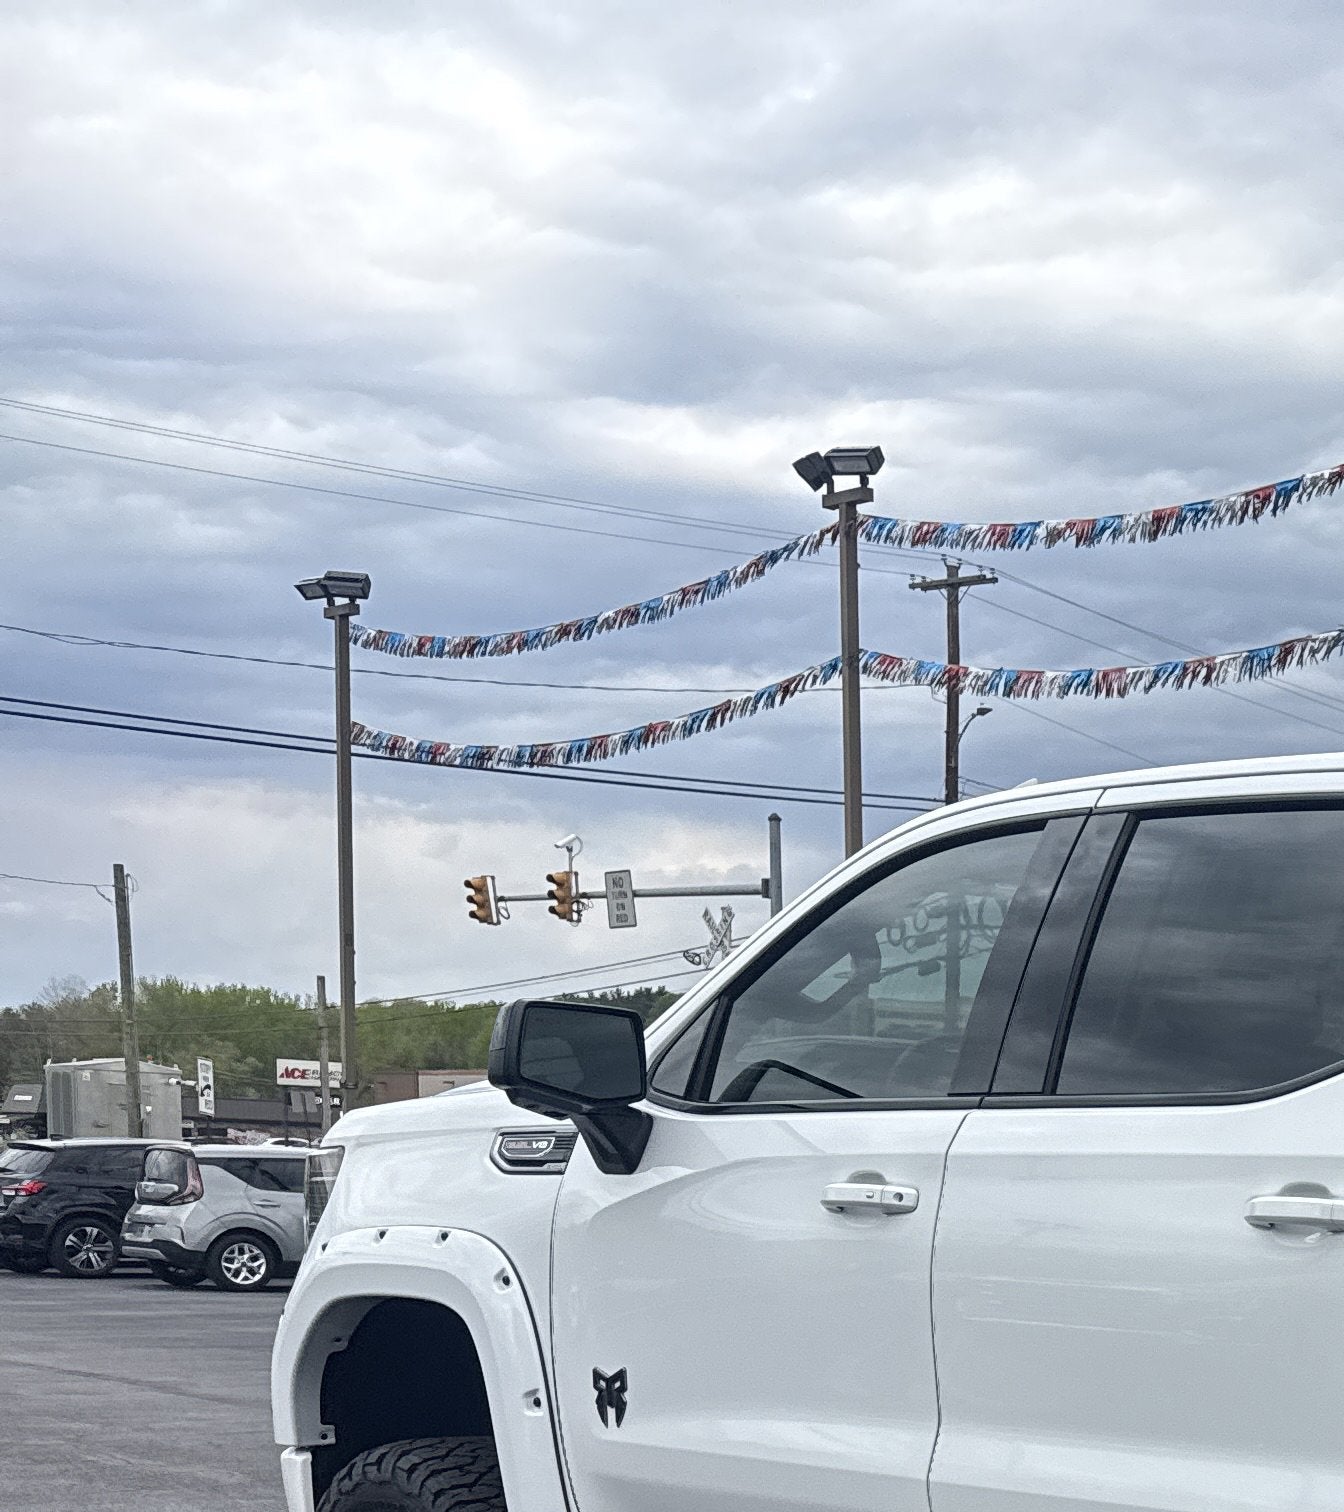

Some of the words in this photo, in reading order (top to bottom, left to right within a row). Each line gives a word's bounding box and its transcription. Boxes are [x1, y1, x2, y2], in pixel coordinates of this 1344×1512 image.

[612, 876, 624, 889] NO
[616, 913, 629, 923] RED
[279, 1066, 311, 1080] ACE
